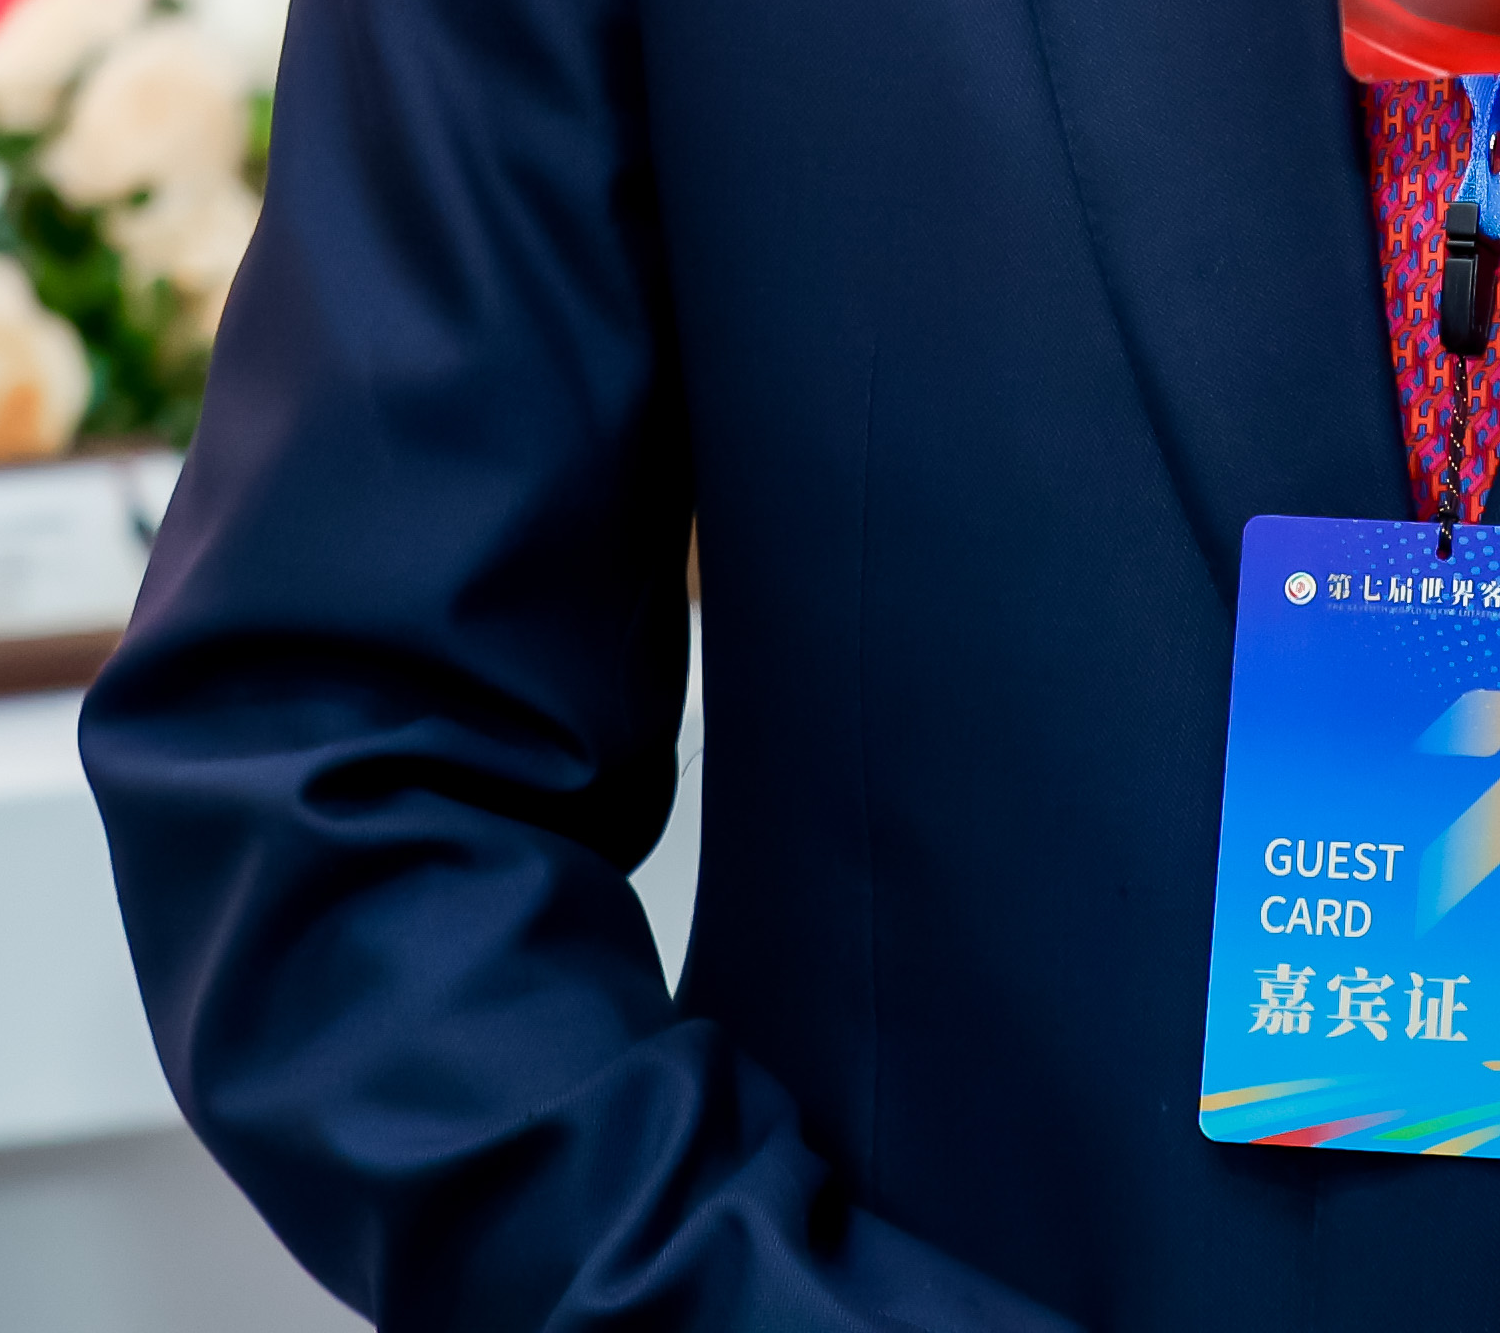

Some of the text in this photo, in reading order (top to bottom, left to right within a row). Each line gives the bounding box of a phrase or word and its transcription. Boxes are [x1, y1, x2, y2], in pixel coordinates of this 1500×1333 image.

[1264, 837, 1405, 882] GUEST
[1260, 895, 1372, 938] CARD
[1248, 963, 1472, 1042] 嘉宾证
